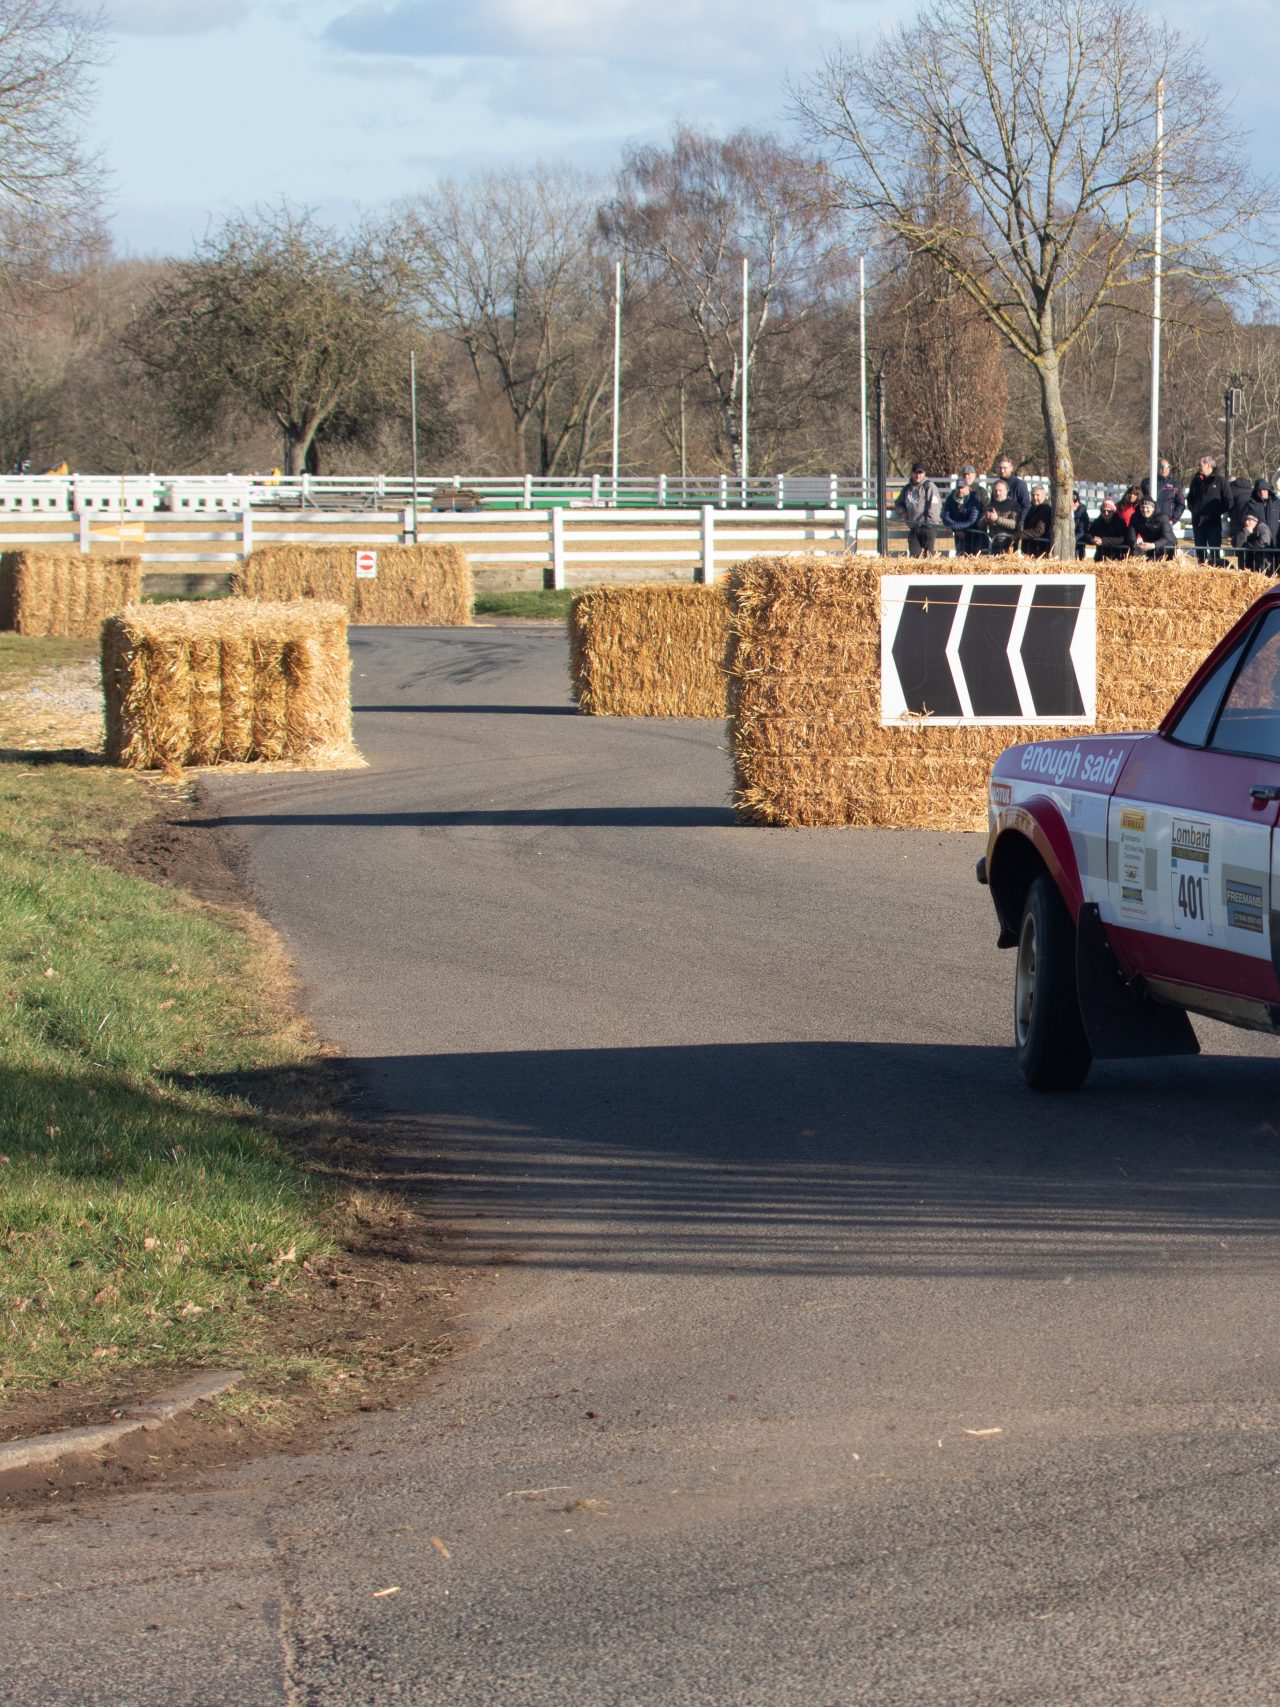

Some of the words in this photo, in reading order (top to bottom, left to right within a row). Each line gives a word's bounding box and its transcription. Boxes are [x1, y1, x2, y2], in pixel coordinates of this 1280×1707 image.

[1021, 743, 1081, 785] enough
[1081, 748, 1124, 785] said
[1172, 822, 1211, 849] Lombard
[1178, 874, 1205, 920] 401
[1226, 890, 1263, 908] FREEMANS
